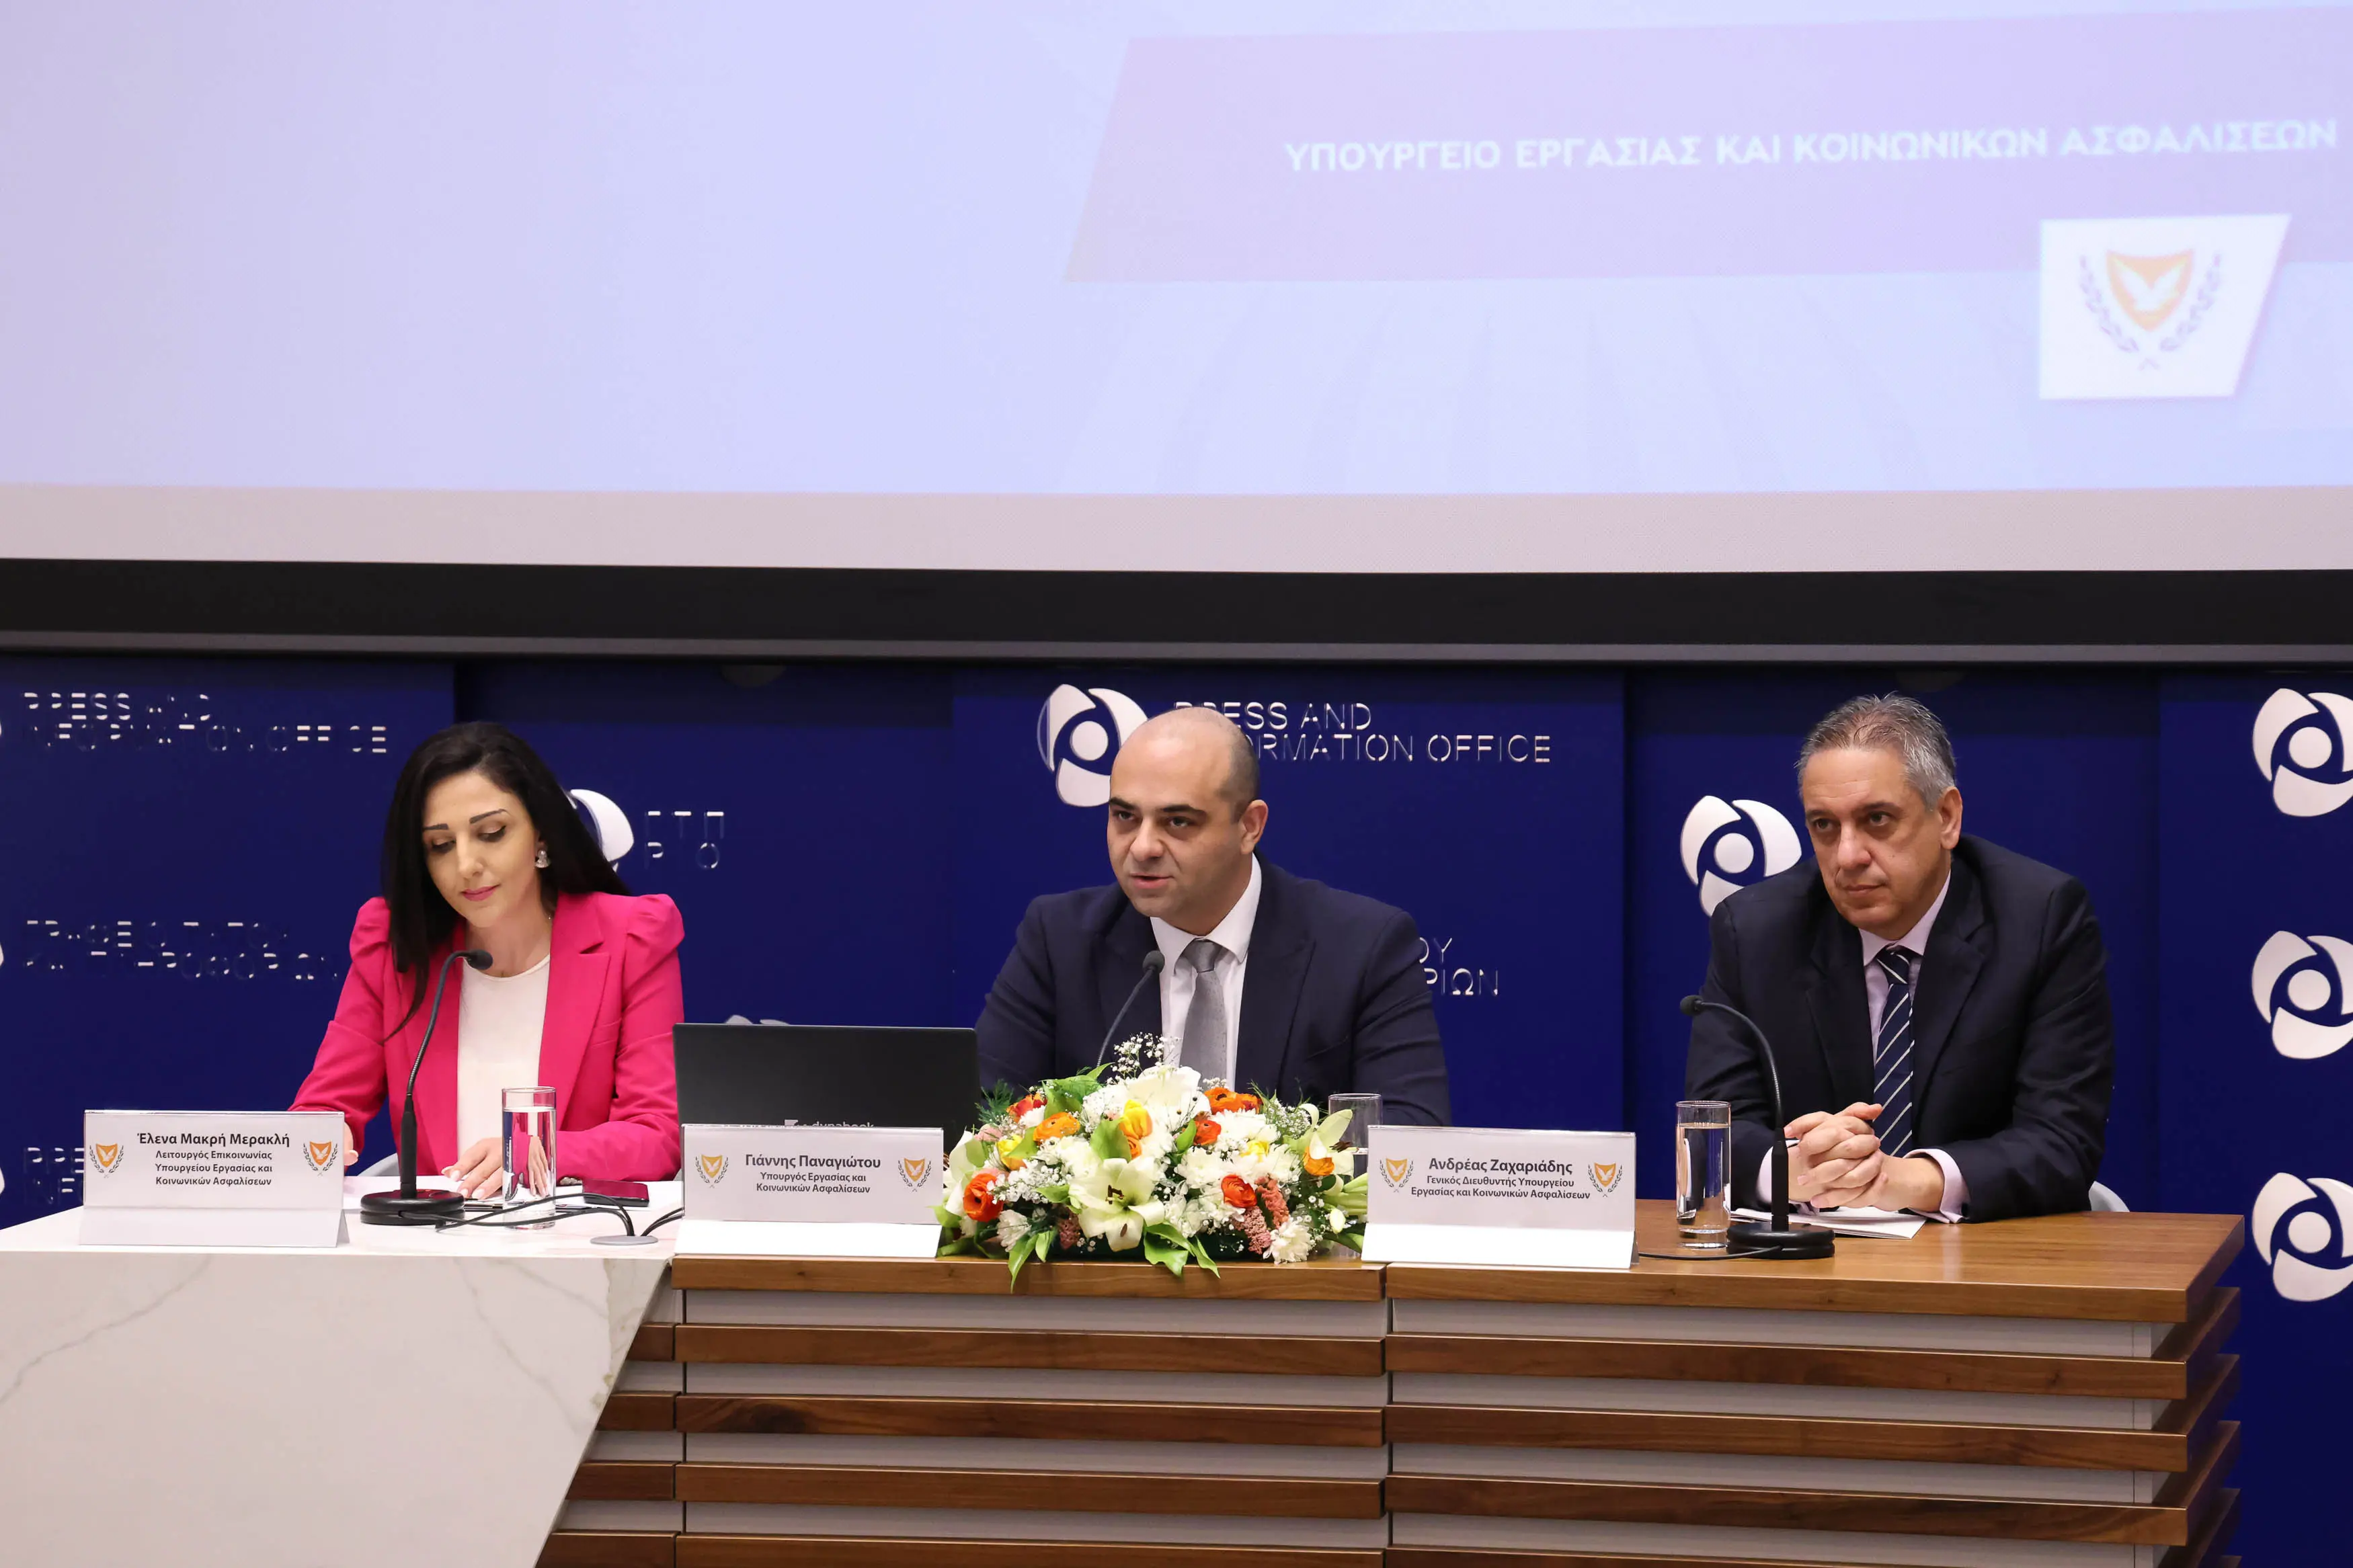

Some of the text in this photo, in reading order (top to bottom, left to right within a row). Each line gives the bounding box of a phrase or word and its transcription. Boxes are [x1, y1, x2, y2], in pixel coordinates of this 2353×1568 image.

[1283, 119, 2337, 171] ΥΠΟΥΡΓΕΙΟ ΕΡΓΑΣΙΑΣ ΚΑΙ ΚΟΙΝΩΝΙΚΩΝ ΑΣΦΑΛΙΣΕΩΝ
[1300, 702, 1371, 730] AND
[1427, 734, 1550, 763] OFFICE
[136, 1132, 290, 1148] Έλενα Μακρή Μερακλή
[155, 1150, 272, 1161] Λειτουργός Επικοινωνίας
[746, 1154, 881, 1170] Γιάννης Παναγιώτου
[155, 1163, 210, 1174] Υπουργείου
[212, 1164, 256, 1173] Εργασίας
[1429, 1158, 1573, 1175] Ανδρέας Ζαχαριάδης
[155, 1176, 272, 1187] Κοινωνικών Ασφαλίσεων
[760, 1172, 807, 1182] Υπουργός
[808, 1173, 850, 1183] Εργασίας
[1427, 1175, 1574, 1188] Γενικός Διευθυντής Υπουργείου
[756, 1183, 871, 1194] Κοινωνικών Ασφαλίσεων
[1411, 1187, 1454, 1198] Εργασίας
[1472, 1188, 1529, 1198] Κοινωνικών
[1530, 1189, 1591, 1200] Ασφαλίσεων
